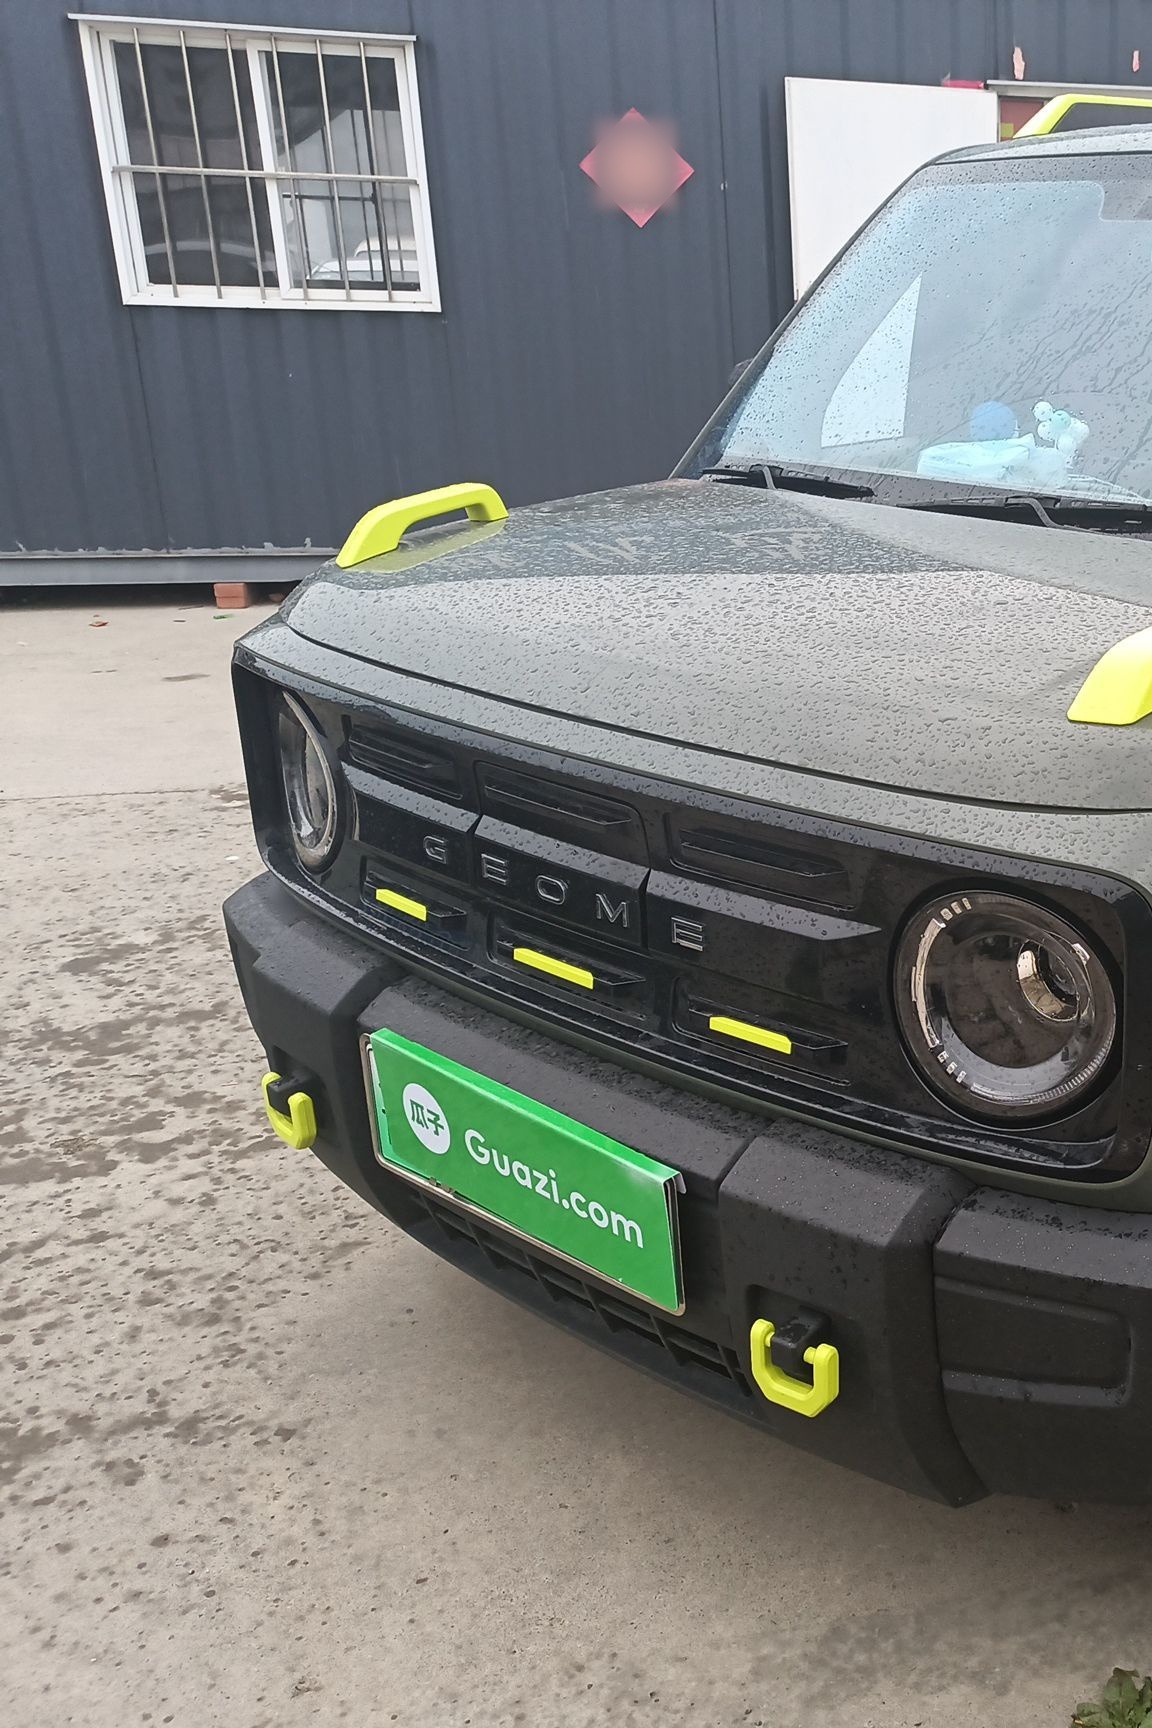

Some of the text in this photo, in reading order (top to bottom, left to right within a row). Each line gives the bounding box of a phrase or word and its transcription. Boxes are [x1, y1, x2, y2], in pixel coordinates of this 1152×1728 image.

[423, 835, 705, 952] GEOME
[409, 1098, 445, 1137] 瓜子
[464, 1128, 644, 1249] Guazi.com
